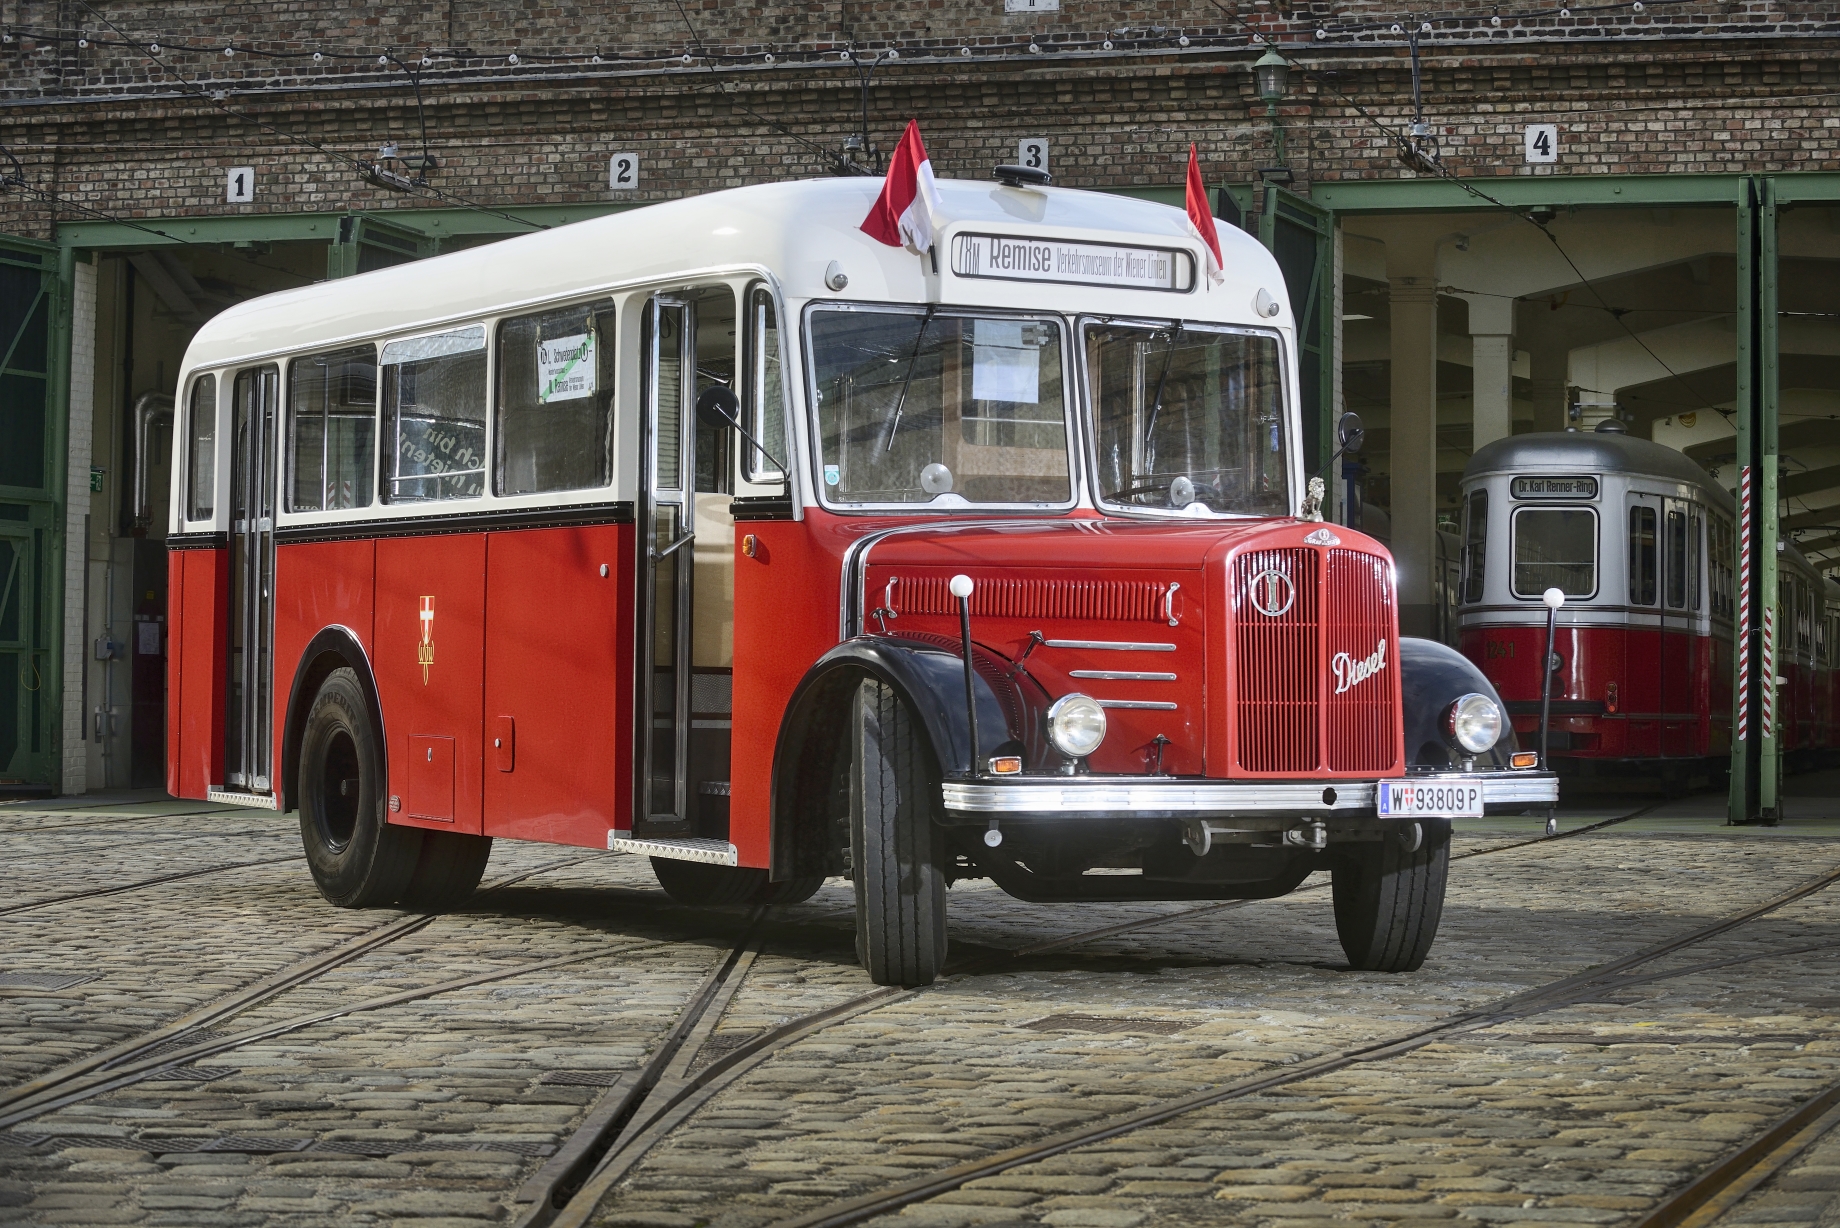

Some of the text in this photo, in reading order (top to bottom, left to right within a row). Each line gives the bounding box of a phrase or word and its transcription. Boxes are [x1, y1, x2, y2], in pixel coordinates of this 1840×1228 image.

[1533, 131, 1550, 156] 4
[1026, 145, 1041, 168] 3
[617, 159, 632, 183] 2
[234, 173, 245, 197] 1
[989, 237, 1051, 273] Remise
[1056, 247, 1112, 277] Verkehrsmuseum
[1113, 251, 1125, 278] der
[1125, 252, 1147, 279] Wiener
[1148, 254, 1167, 280] Linien
[1518, 480, 1594, 494] Dr. Karl Renner-Ring
[1331, 638, 1387, 695] Diesel
[1382, 802, 1388, 810] A
[1392, 788, 1477, 811] W 93809 P
